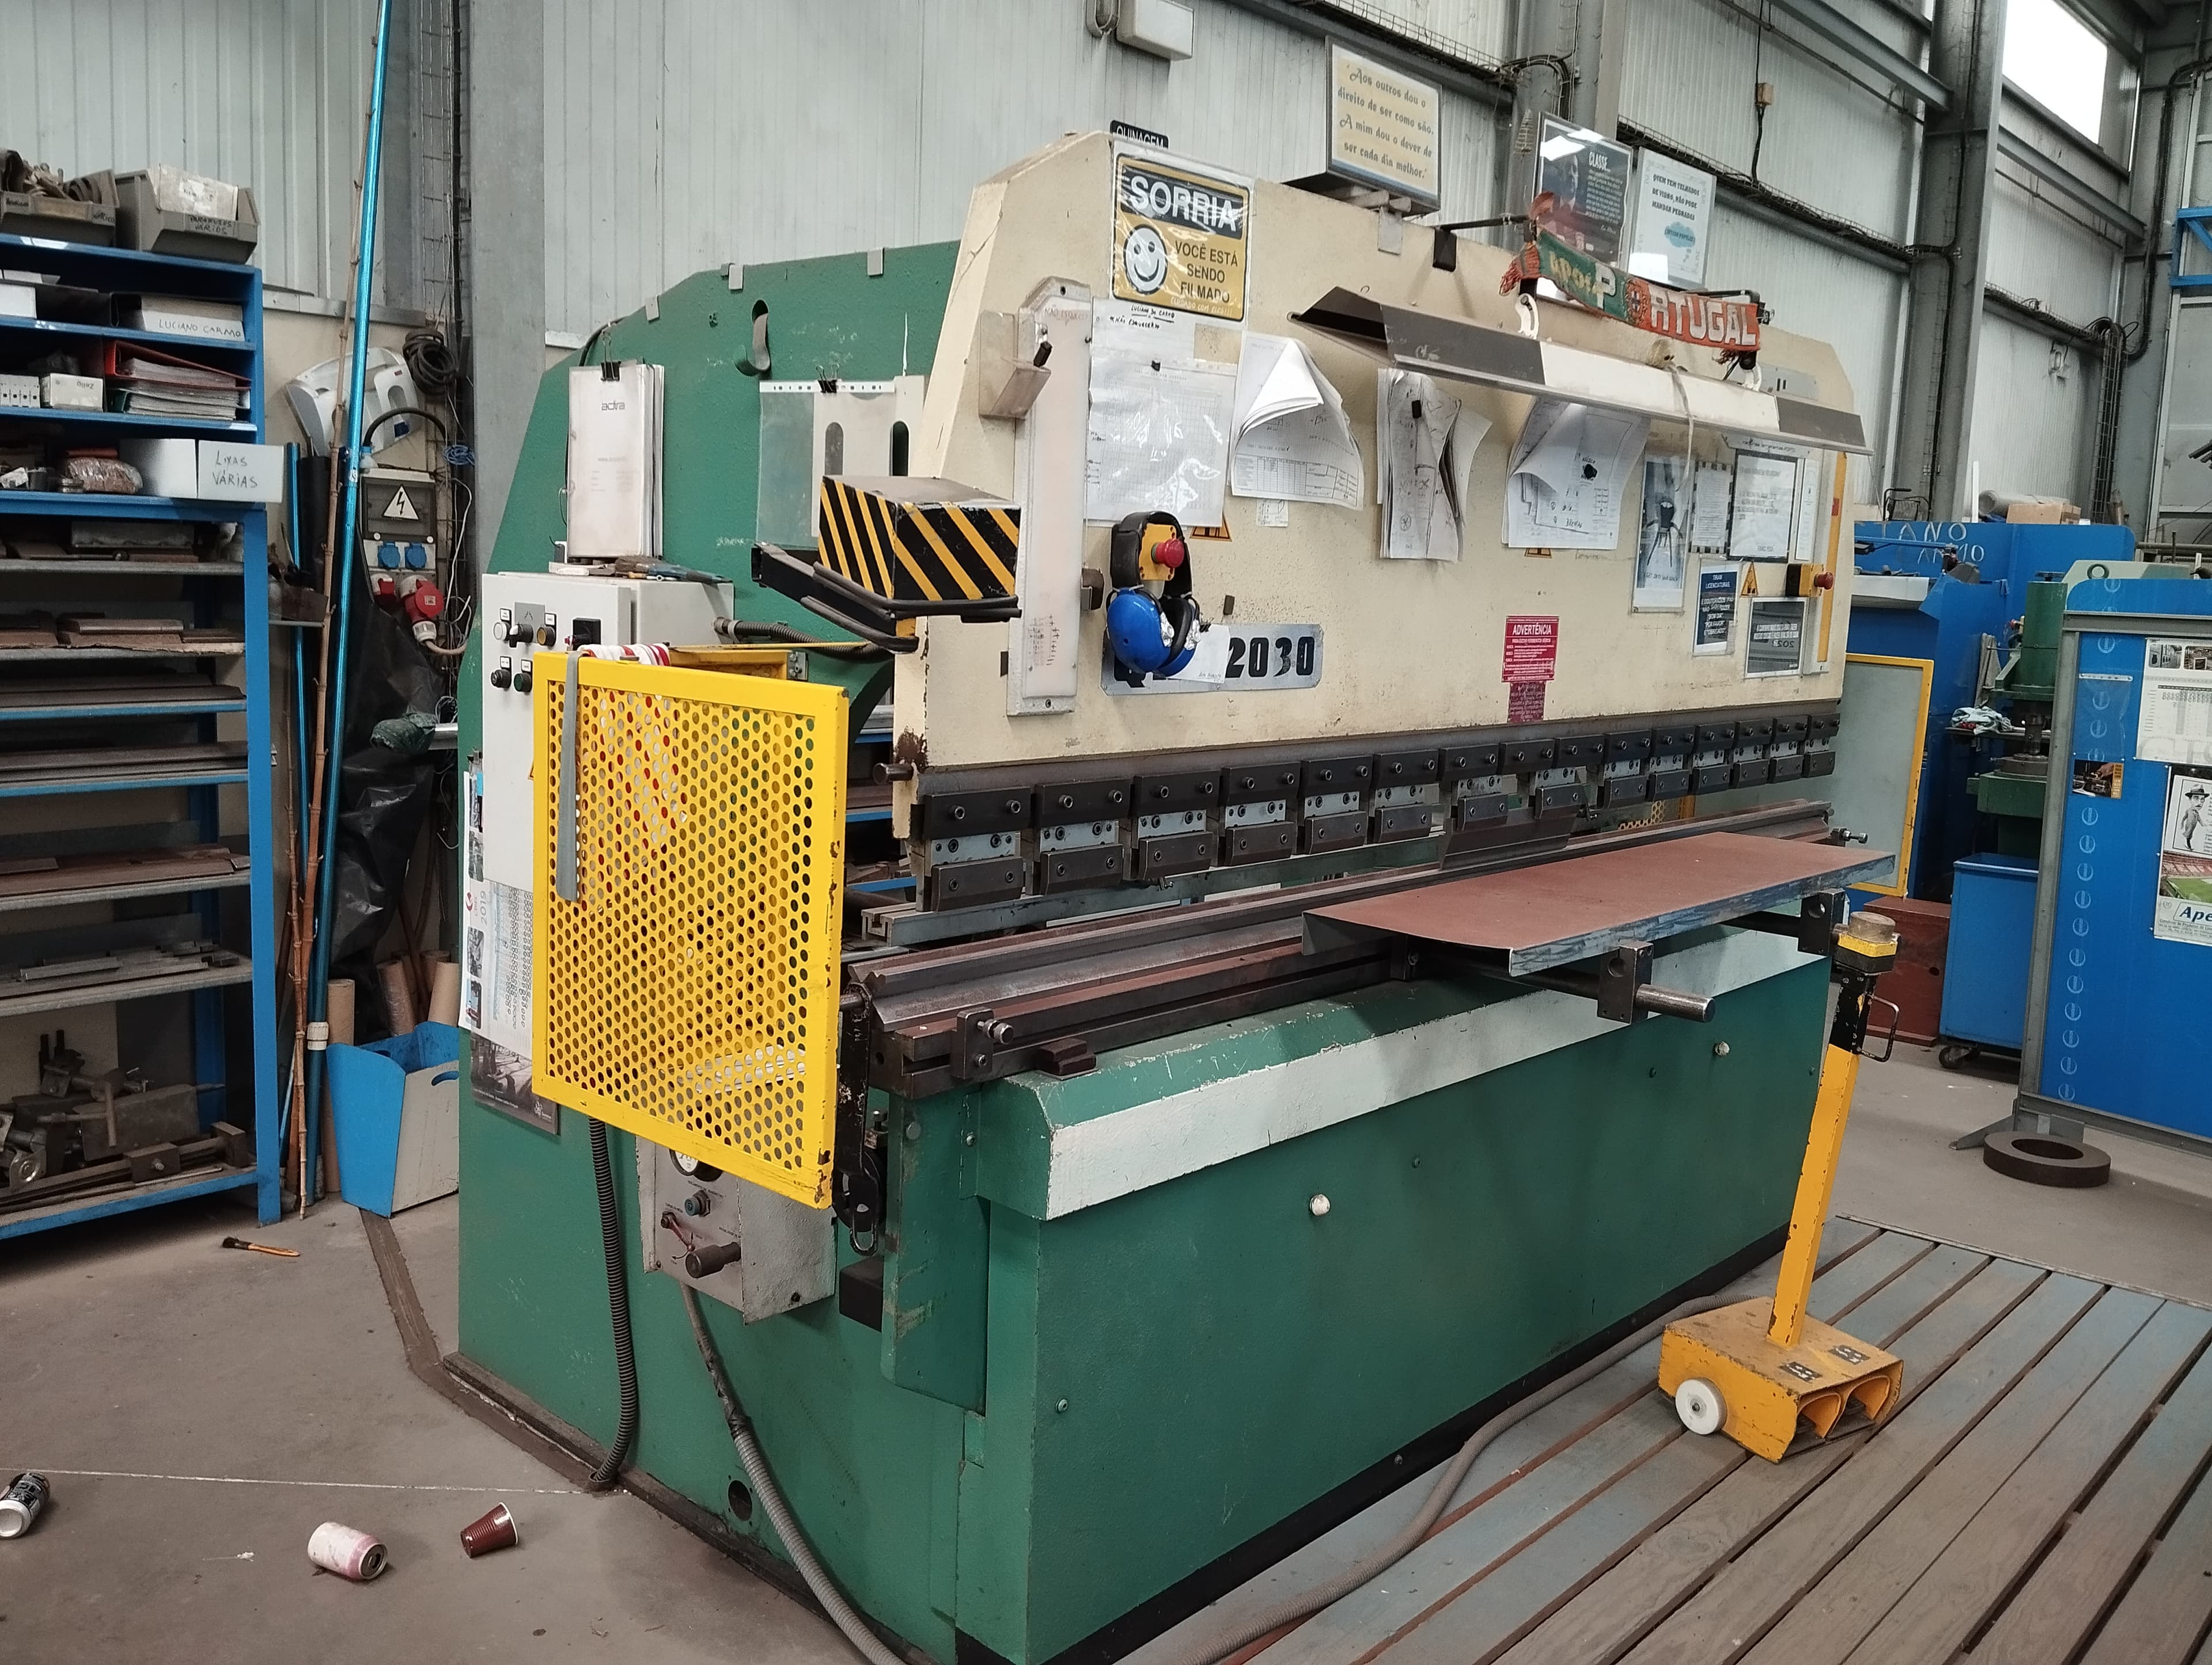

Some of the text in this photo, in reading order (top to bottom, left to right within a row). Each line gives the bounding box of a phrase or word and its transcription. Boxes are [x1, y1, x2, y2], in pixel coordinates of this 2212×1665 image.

[1338, 86, 1365, 107] direito
[1368, 98, 1377, 112] de
[1380, 105, 1392, 118] ser
[1395, 112, 1415, 128] como
[1376, 79, 1402, 97] outros
[1404, 89, 1418, 105] dou
[1421, 100, 1426, 108] o
[1339, 113, 1433, 158] A mim dou o dever de
[1344, 142, 1358, 154] ser
[1359, 147, 1378, 162] cada
[1381, 154, 1393, 168] dia
[1667, 180, 1677, 188] TEM
[1130, 176, 1237, 232] SORRIA
[1175, 240, 1238, 267] VOCÊ ESTÁ
[1187, 263, 1225, 283] SENDO
[1181, 281, 1230, 303] FILMADO
